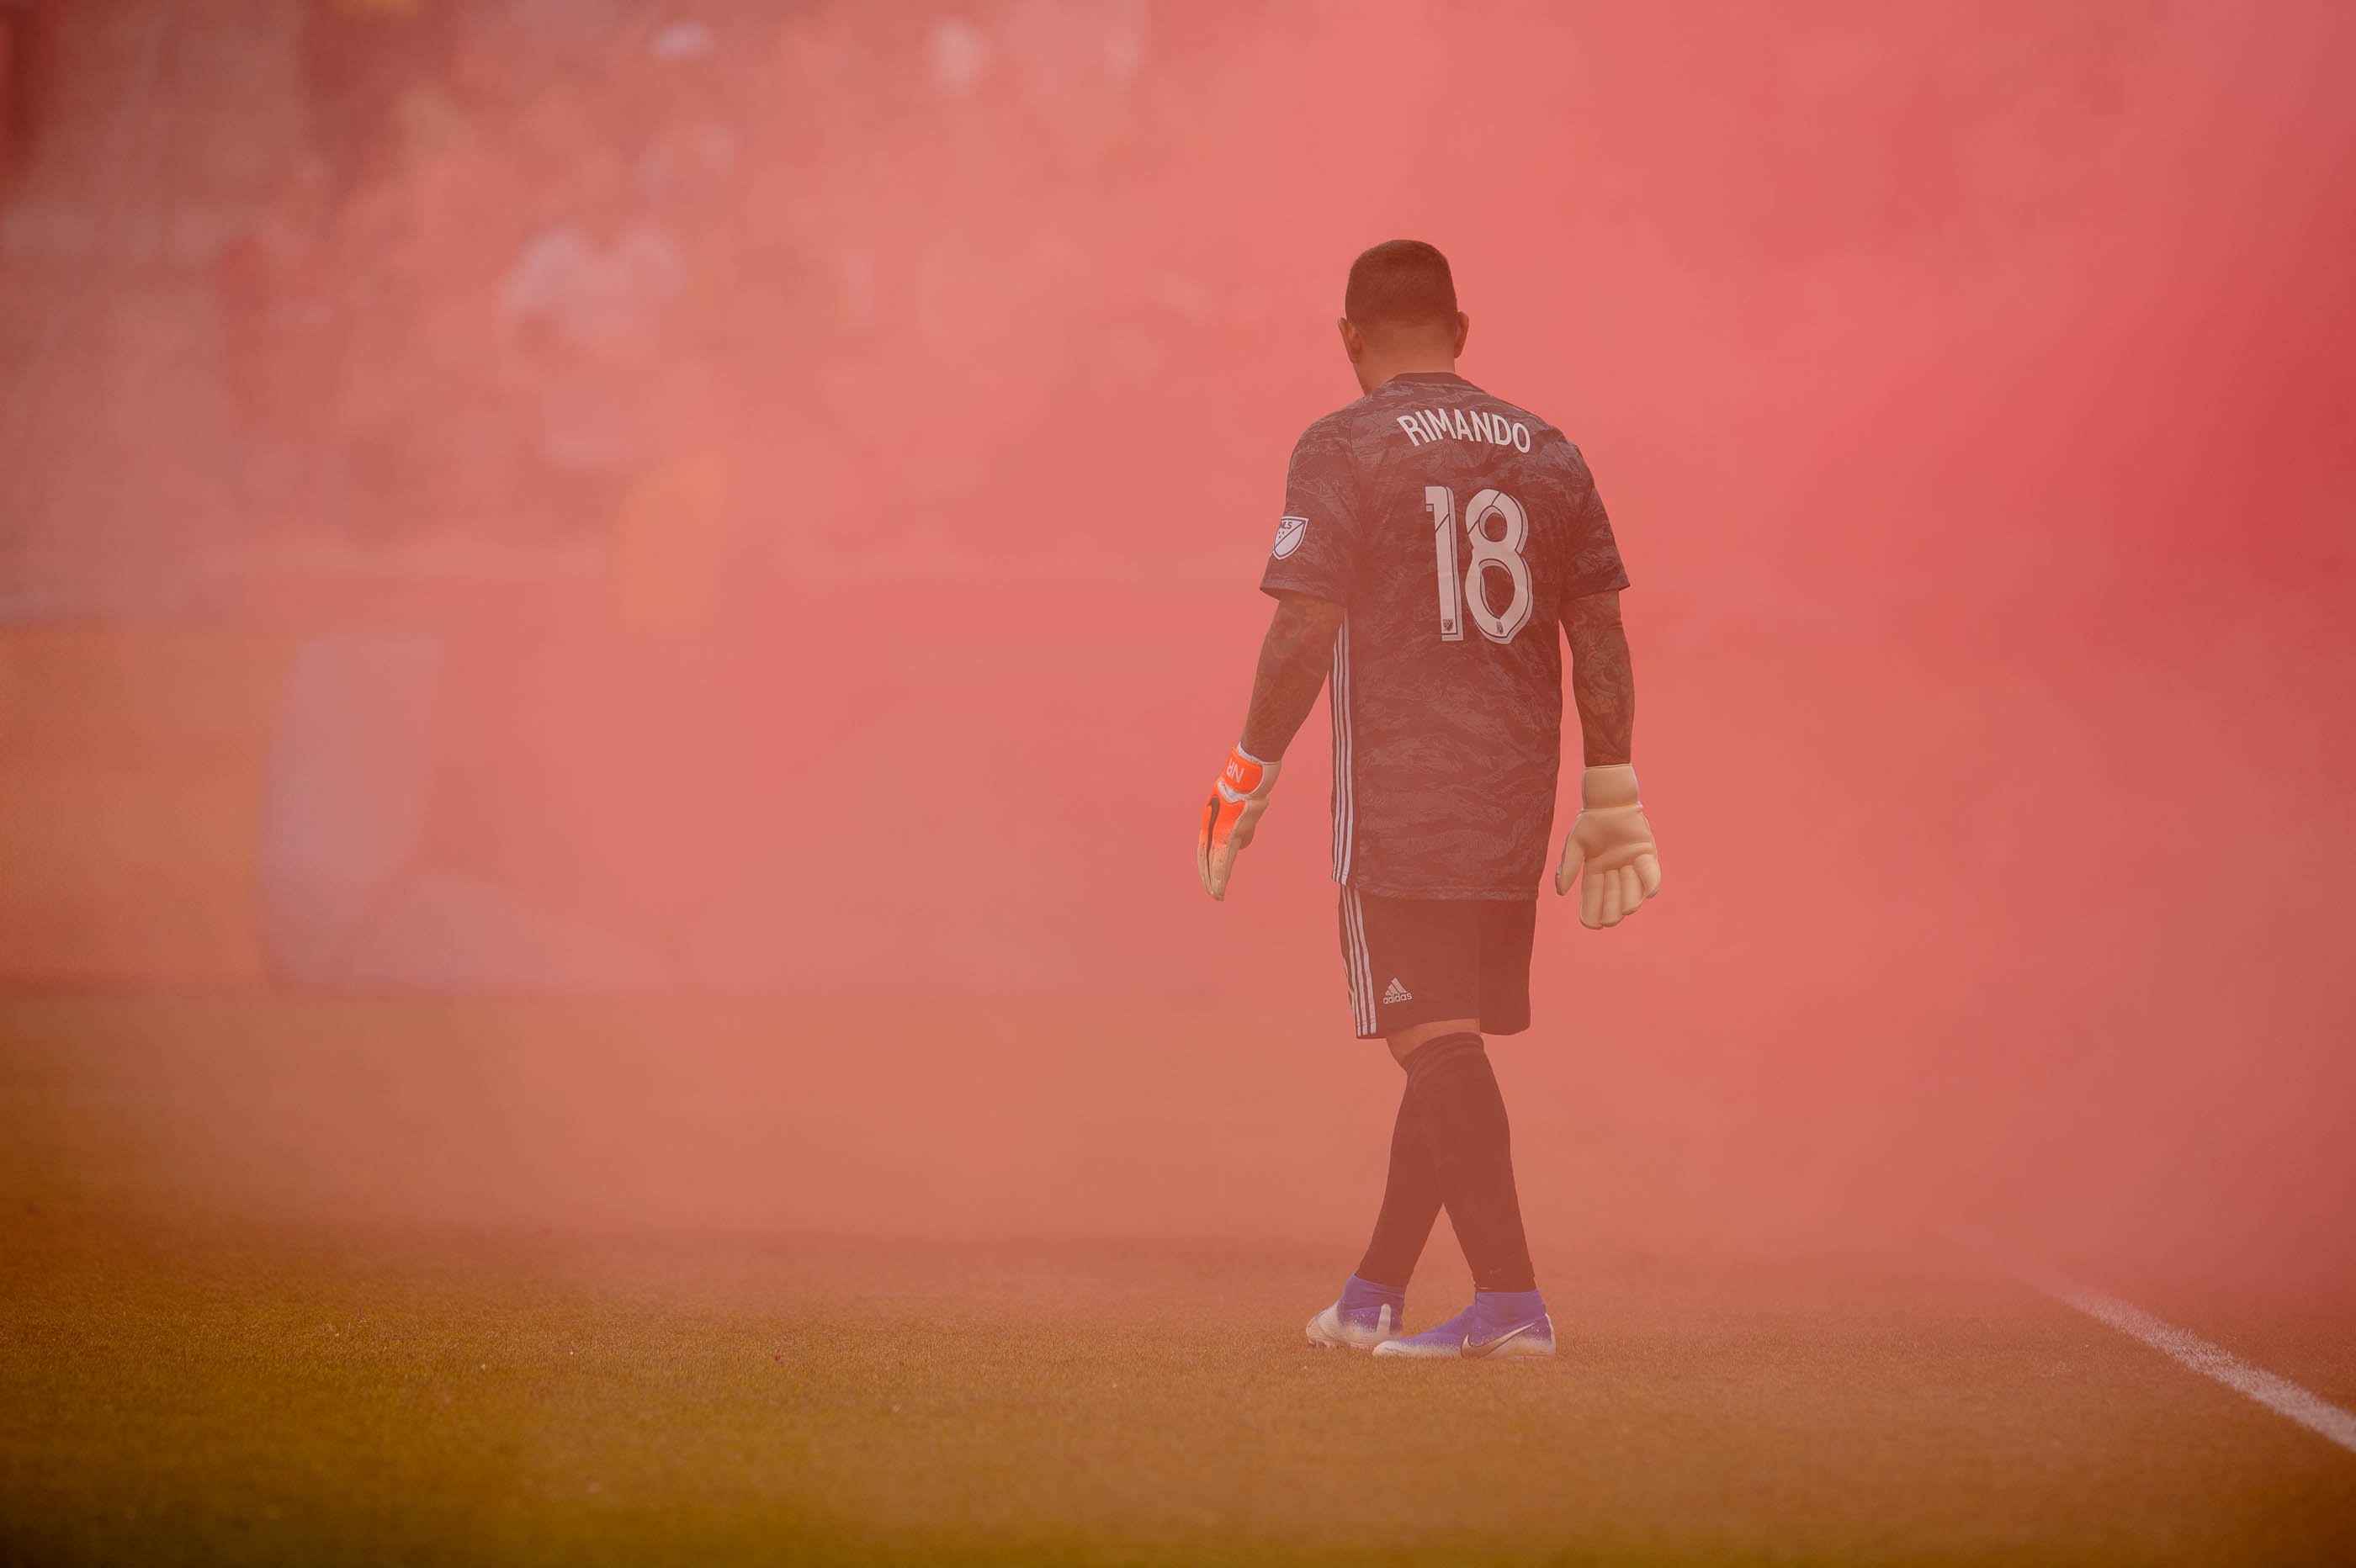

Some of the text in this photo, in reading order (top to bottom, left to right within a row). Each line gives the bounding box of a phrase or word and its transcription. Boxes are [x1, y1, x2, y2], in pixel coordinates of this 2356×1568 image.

[1397, 408, 1531, 453] RIMANDO
[1425, 485, 1534, 644] 18
[1382, 993, 1413, 1004] adidas
